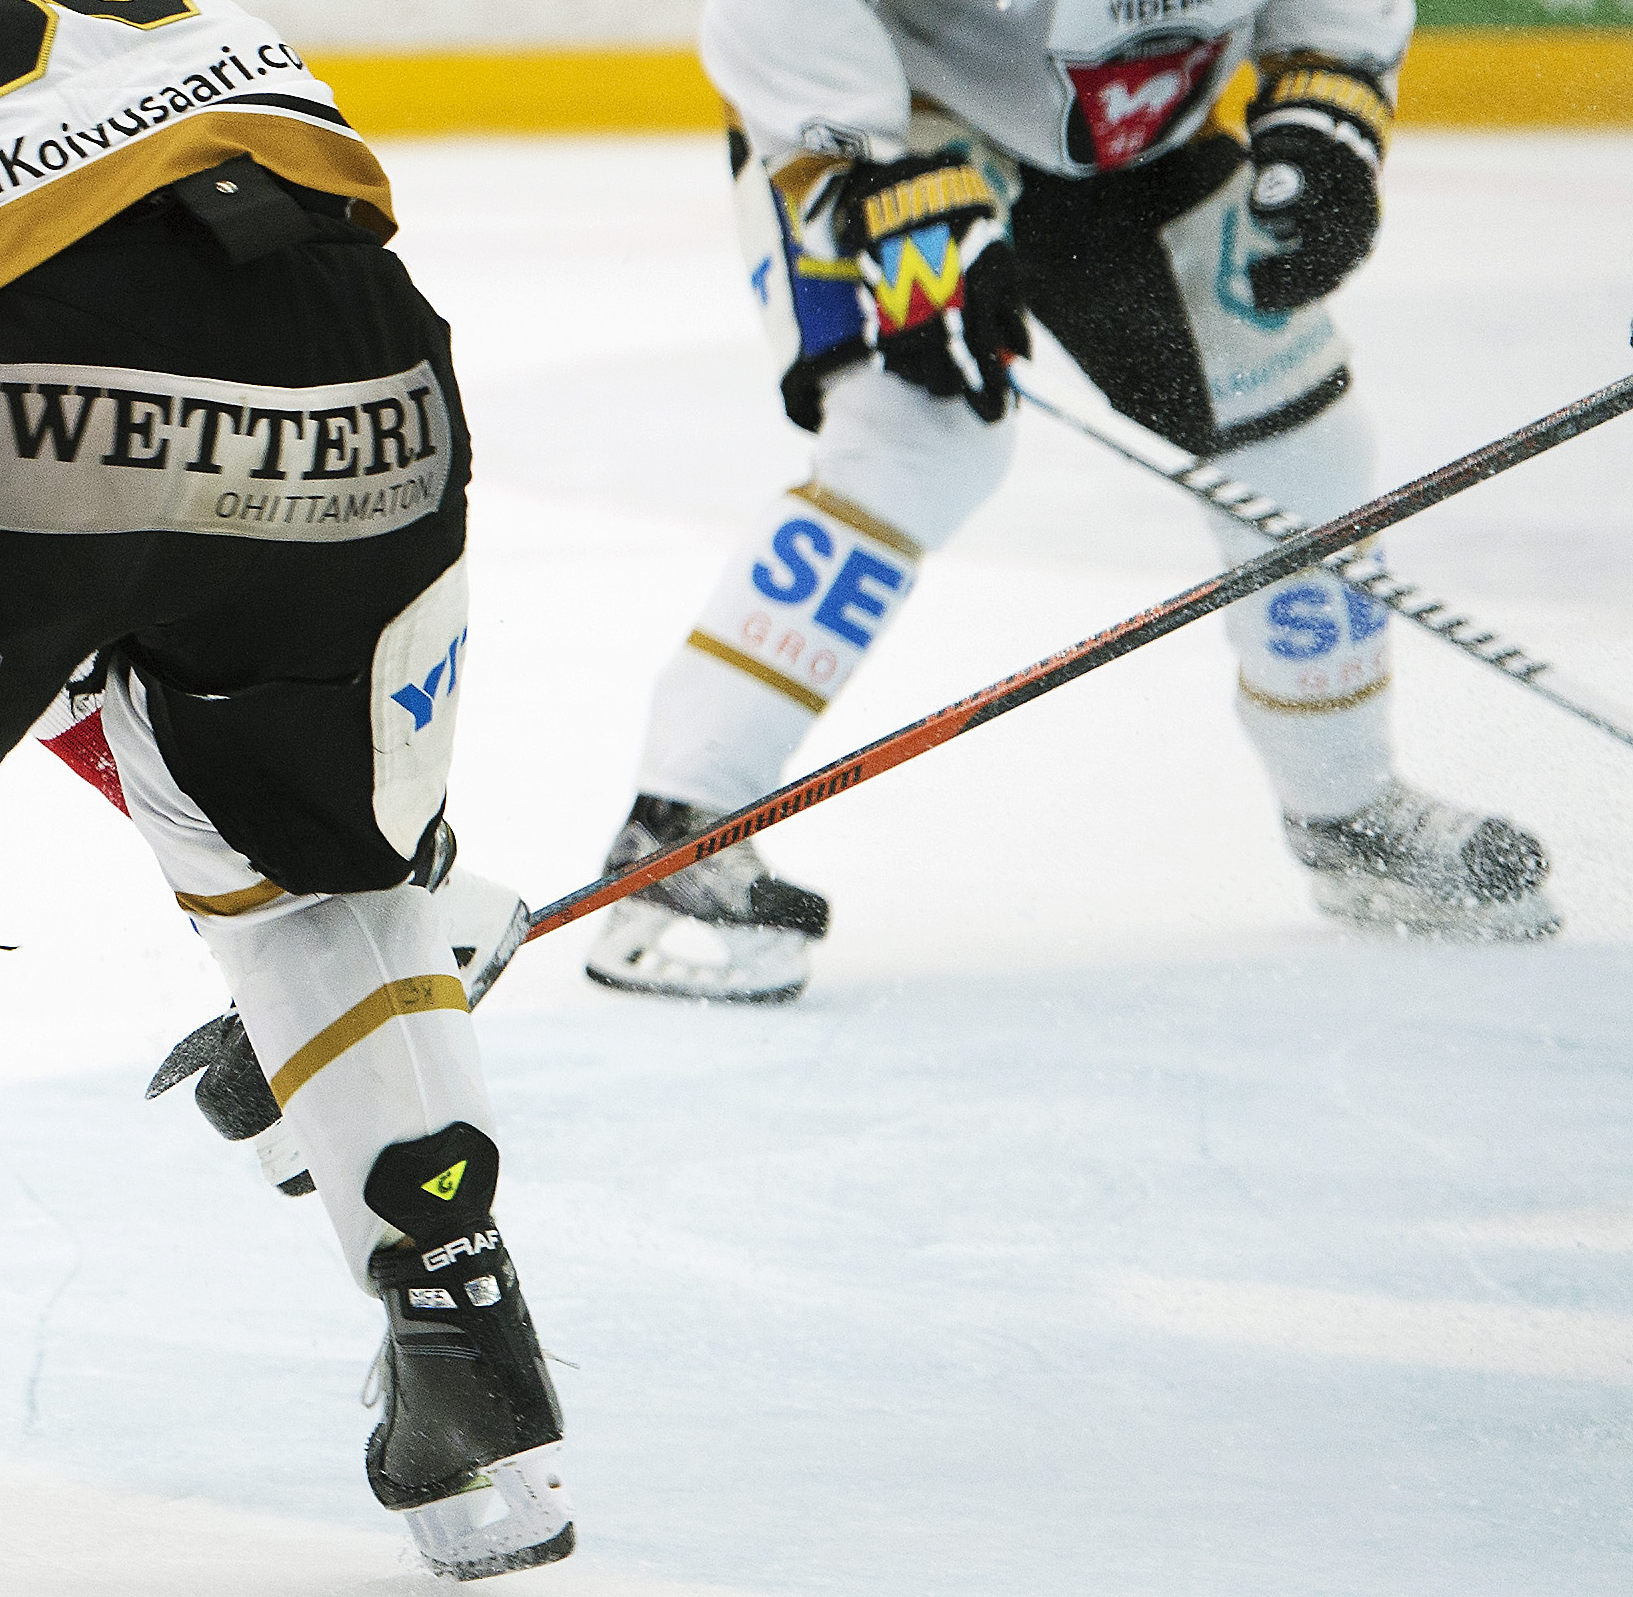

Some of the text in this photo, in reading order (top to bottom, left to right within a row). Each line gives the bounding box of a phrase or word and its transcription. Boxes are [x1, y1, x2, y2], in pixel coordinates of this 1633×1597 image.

[0, 383, 438, 481] WETTERI
[751, 516, 912, 650] SE
[390, 625, 469, 731] YI
[740, 610, 842, 685] GRO
[421, 1228, 501, 1272] GRAF
